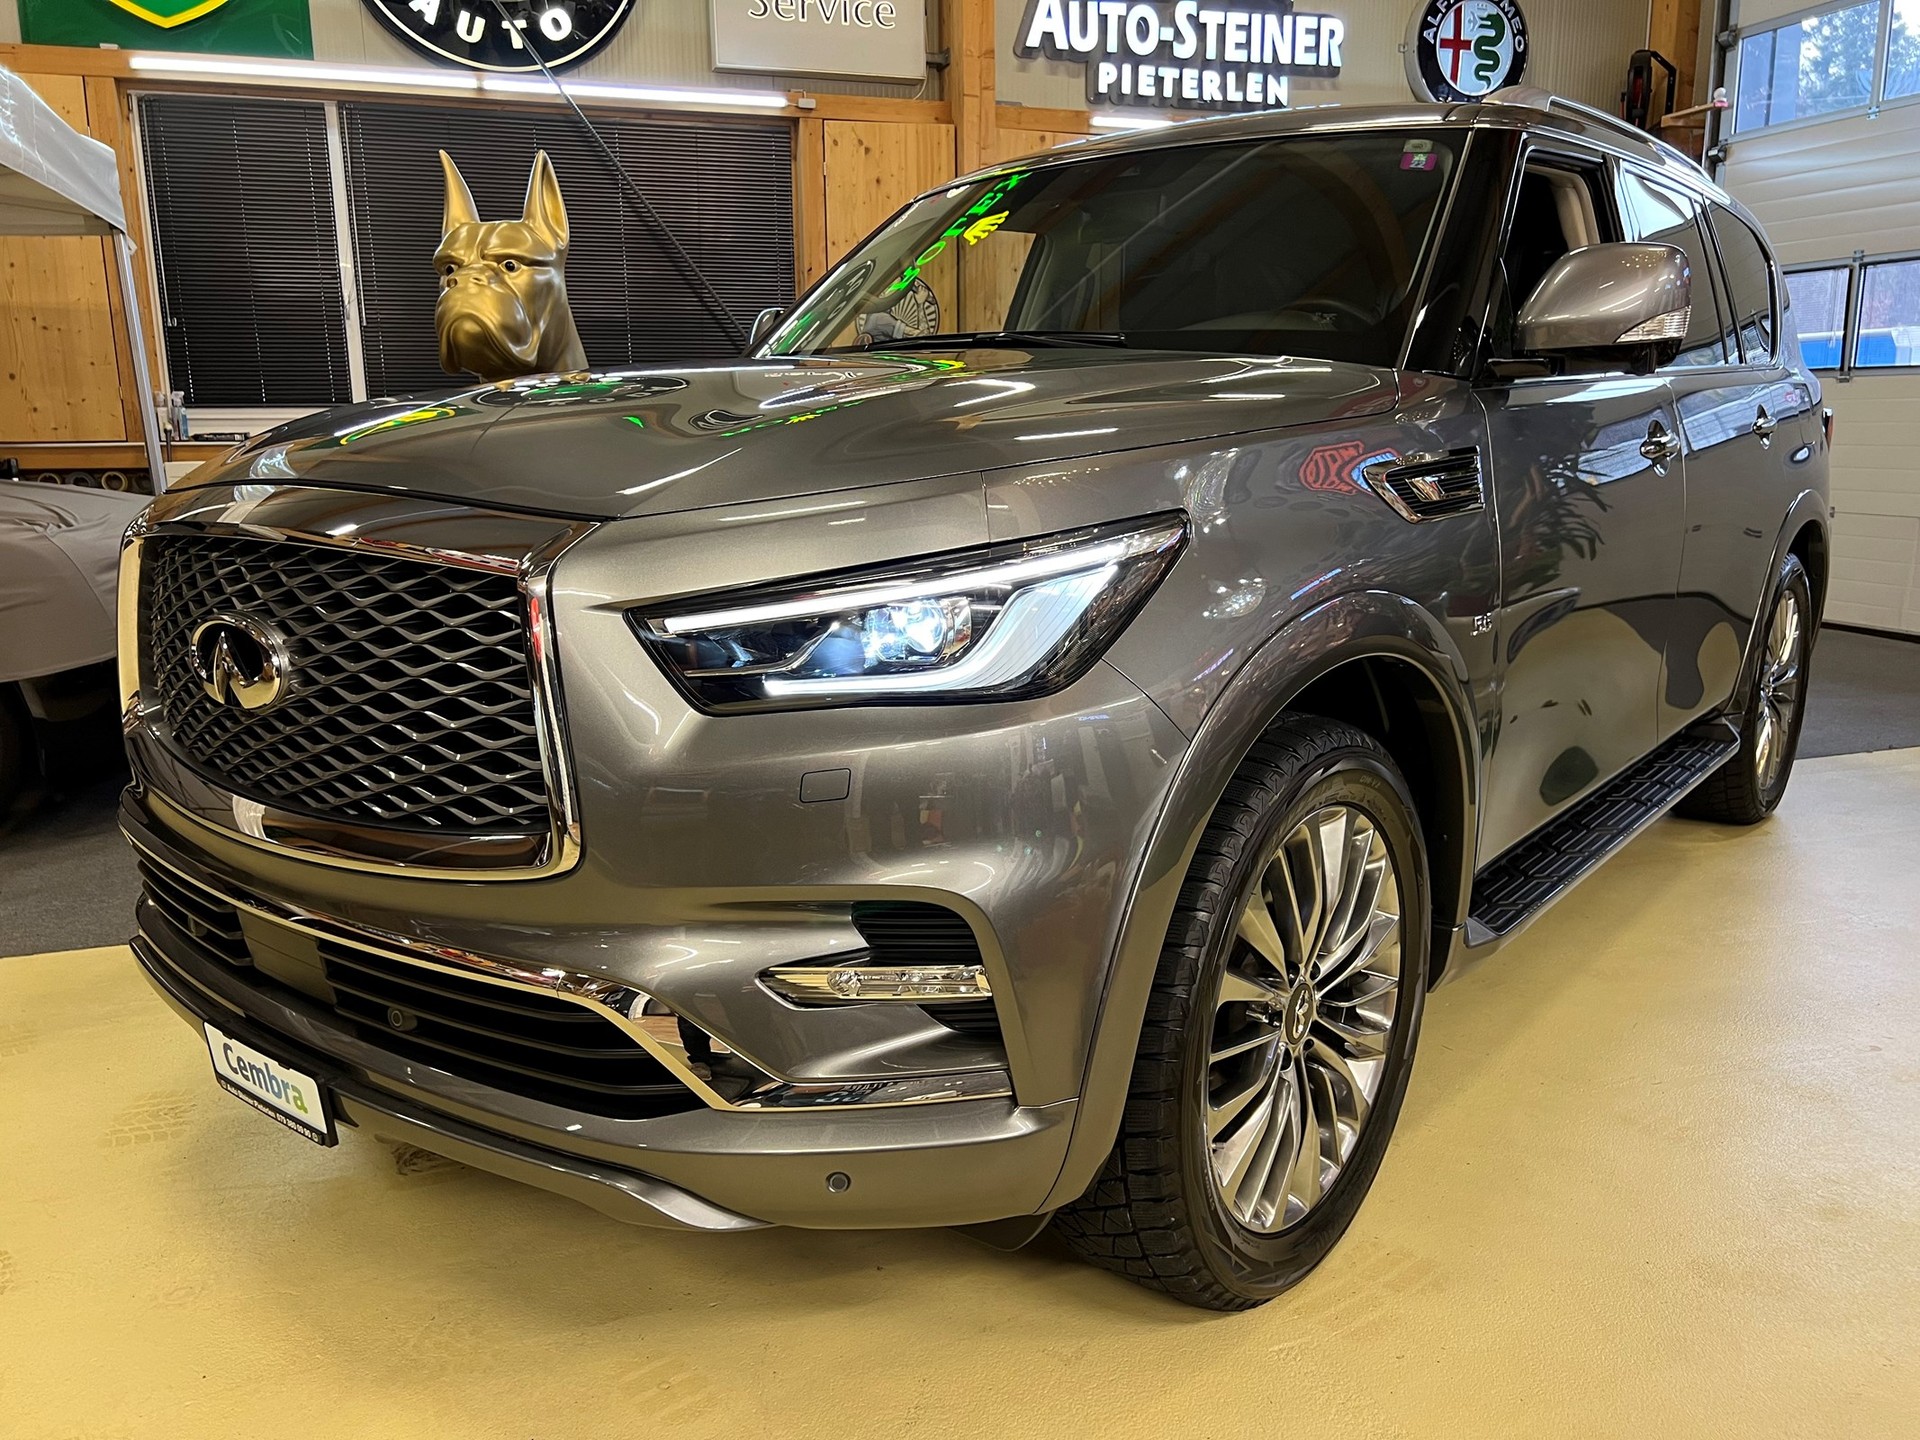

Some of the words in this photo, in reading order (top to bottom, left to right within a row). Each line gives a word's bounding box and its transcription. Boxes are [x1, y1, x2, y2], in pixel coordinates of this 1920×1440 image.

[408, 0, 573, 49] AUTO
[748, 0, 896, 29] Service
[1025, 0, 1345, 67] AUTO-STEINER
[1423, 0, 1454, 44] ALF
[1098, 62, 1289, 106] PIETERLEN
[223, 1042, 308, 1114] Cembra
